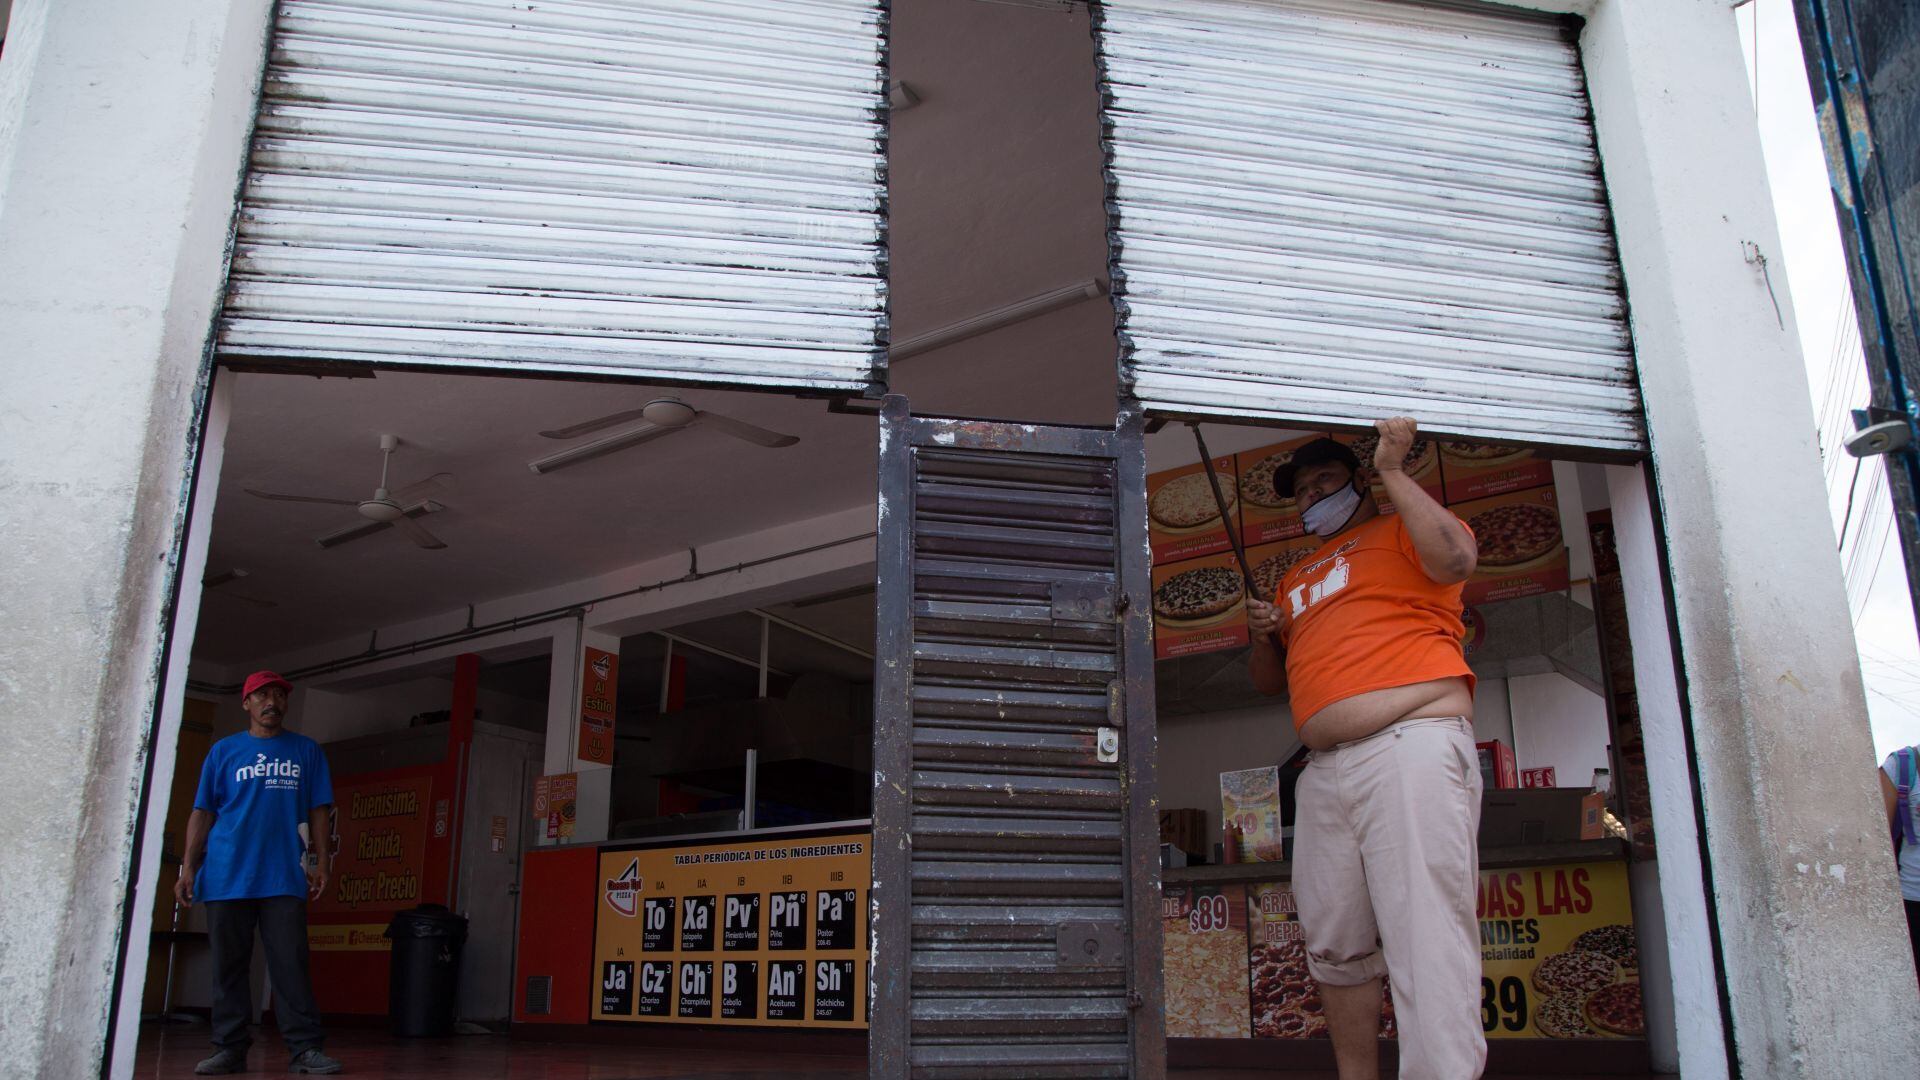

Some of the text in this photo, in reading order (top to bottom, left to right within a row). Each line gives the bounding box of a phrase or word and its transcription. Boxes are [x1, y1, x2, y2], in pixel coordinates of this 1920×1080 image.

[1542, 492, 1552, 501] 10
[594, 682, 605, 695] Al
[585, 696, 612, 713] Estilo
[236, 753, 301, 783] mérida
[357, 829, 404, 865] Rápida,
[675, 844, 863, 865] TABLA PERIÓDICA DE LOS INGREDIENTES
[376, 869, 417, 901] Precio
[697, 879, 707, 888] IIA
[737, 877, 745, 886] IB
[782, 875, 793, 885] IIB
[830, 872, 844, 882] IIIB
[1534, 867, 1593, 915] LAS
[645, 899, 675, 930] To 2
[683, 898, 715, 930] Xa 4
[725, 897, 759, 928] Pv 6
[770, 893, 806, 928] Pñ 8
[818, 891, 855, 921] Pa 10
[1190, 895, 1229, 933] $89
[1261, 892, 1298, 914] GRAN
[817, 929, 834, 937] Pastor
[1265, 921, 1305, 942] PEPP
[617, 947, 624, 956] IA
[603, 964, 626, 990] Ja
[642, 962, 672, 993] Cz 3
[681, 963, 712, 995] Ch 5
[723, 963, 757, 994] B 7
[768, 964, 803, 996] An 9
[816, 961, 852, 991] Sh 11
[769, 999, 796, 1007] Aceituna
[816, 998, 845, 1007] Salchicha
